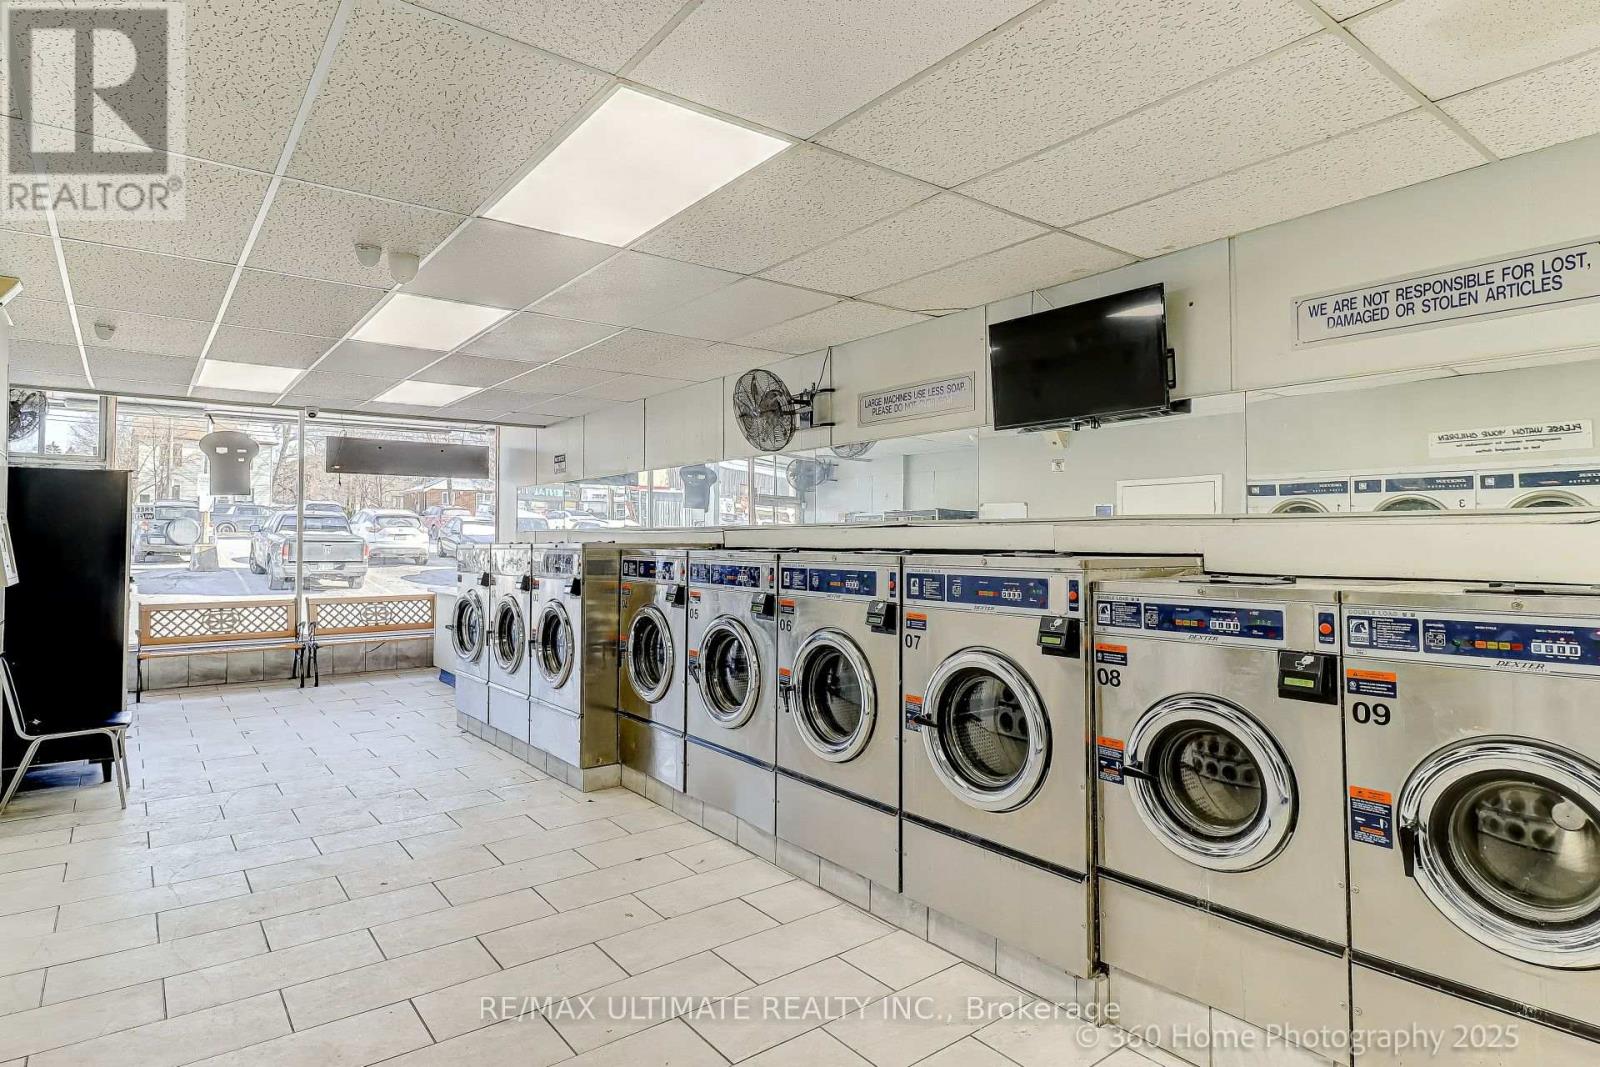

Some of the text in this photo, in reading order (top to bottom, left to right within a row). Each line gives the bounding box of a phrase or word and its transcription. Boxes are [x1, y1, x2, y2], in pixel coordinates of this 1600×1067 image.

[1308, 252, 1591, 318] WE ARE NOT RESPONSIBLE FOR LOST,
[1327, 275, 1563, 329] DAMAGED OR STOLEN ARTICLES
[864, 397, 882, 408] LARGE
[884, 391, 912, 405] MACHINES
[913, 388, 926, 399] USE
[928, 385, 944, 397] LESS
[872, 404, 892, 416] PLEASE
[894, 402, 902, 412] DO
[690, 608, 699, 620] 05
[780, 619, 792, 632] 06
[905, 633, 921, 650] 07
[1188, 634, 1220, 642] DEXTER
[1496, 660, 1546, 669] DEXTER
[1097, 668, 1121, 687] 08
[1352, 701, 1391, 726] 09
